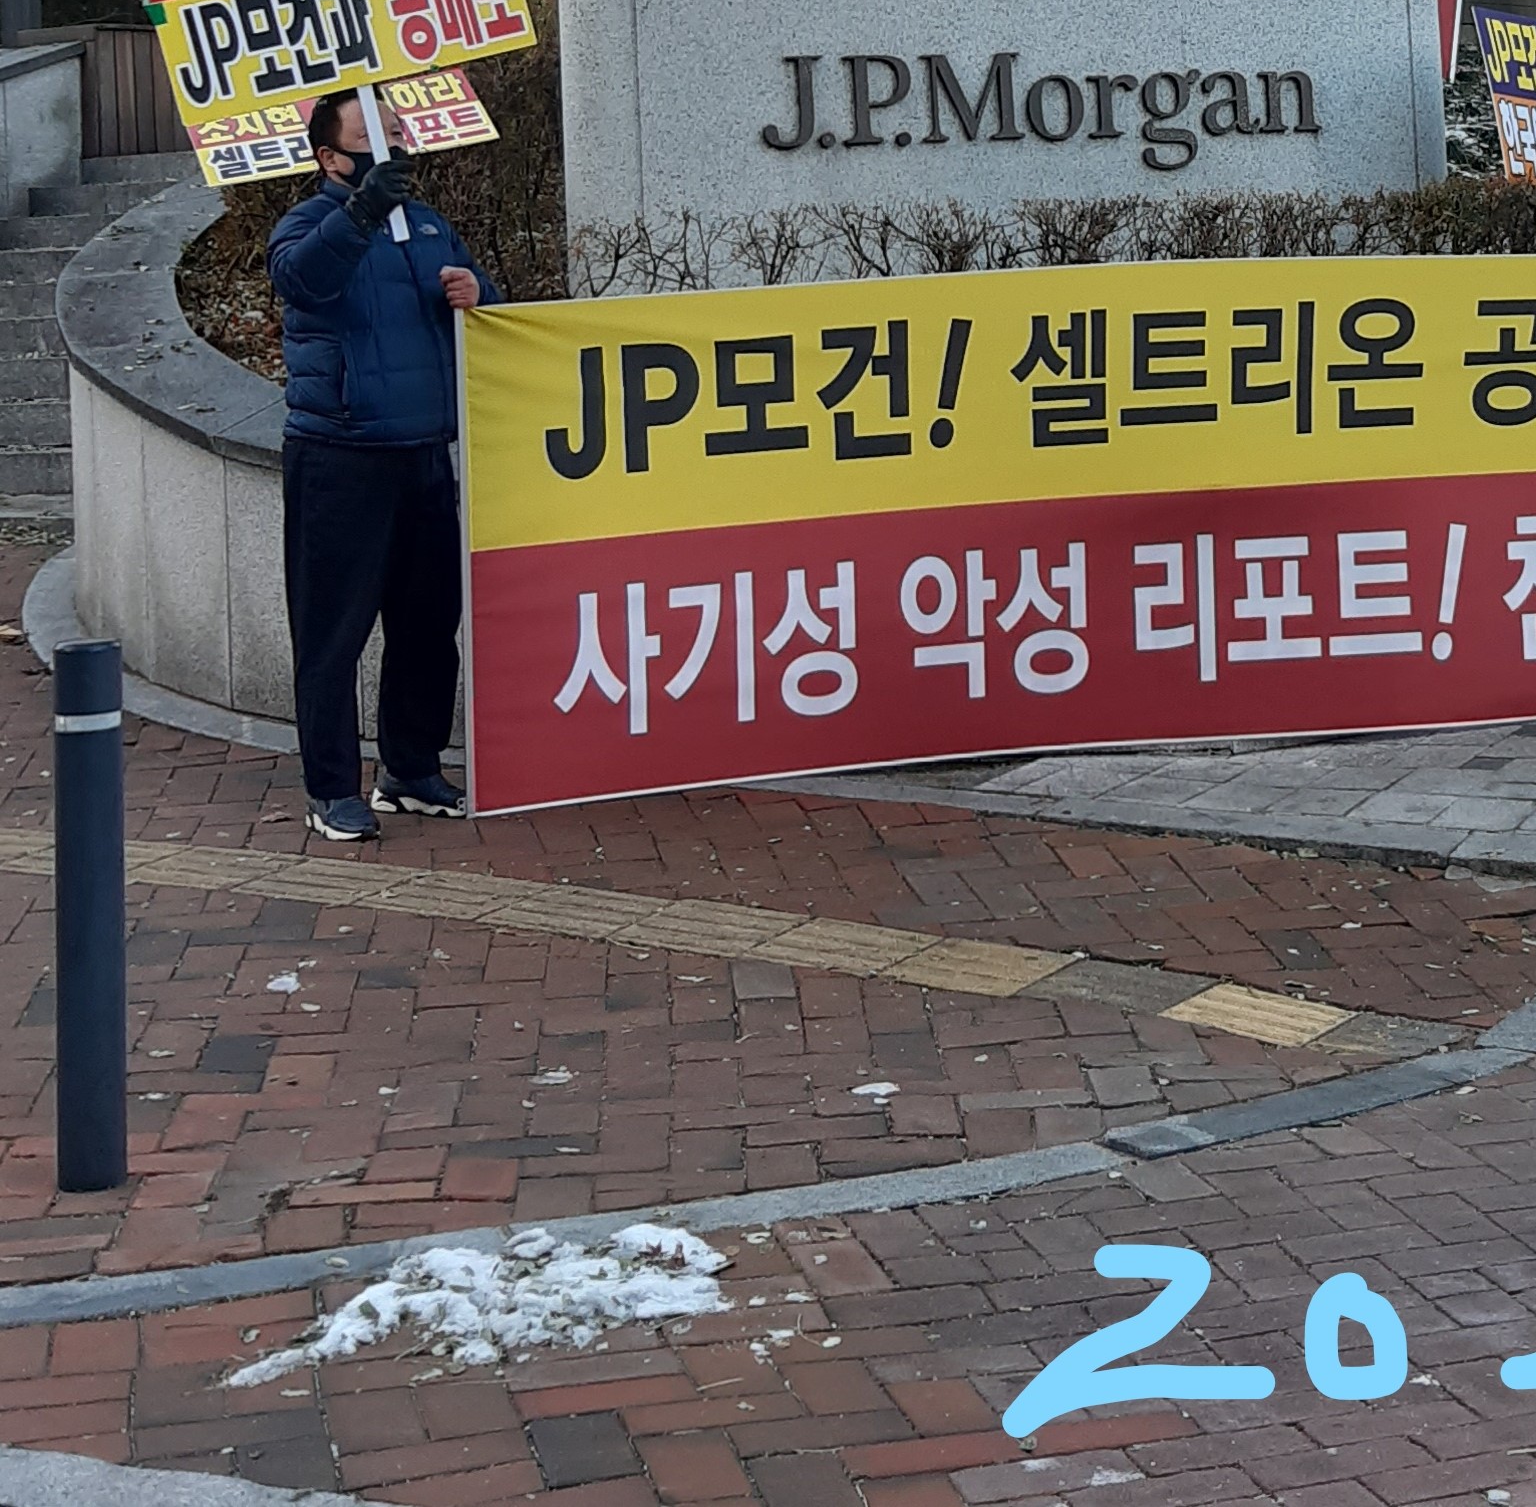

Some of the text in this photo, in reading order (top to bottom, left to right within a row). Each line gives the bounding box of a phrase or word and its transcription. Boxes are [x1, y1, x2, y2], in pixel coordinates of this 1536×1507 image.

[379, 72, 467, 113] 하라
[762, 51, 1323, 172] J.P.Morgan
[544, 317, 973, 481] JP모건!
[1009, 295, 1425, 449] 셀트리온
[553, 559, 859, 736] 사기성
[898, 540, 1091, 699] 악성
[1132, 523, 1468, 684] 리포트!
